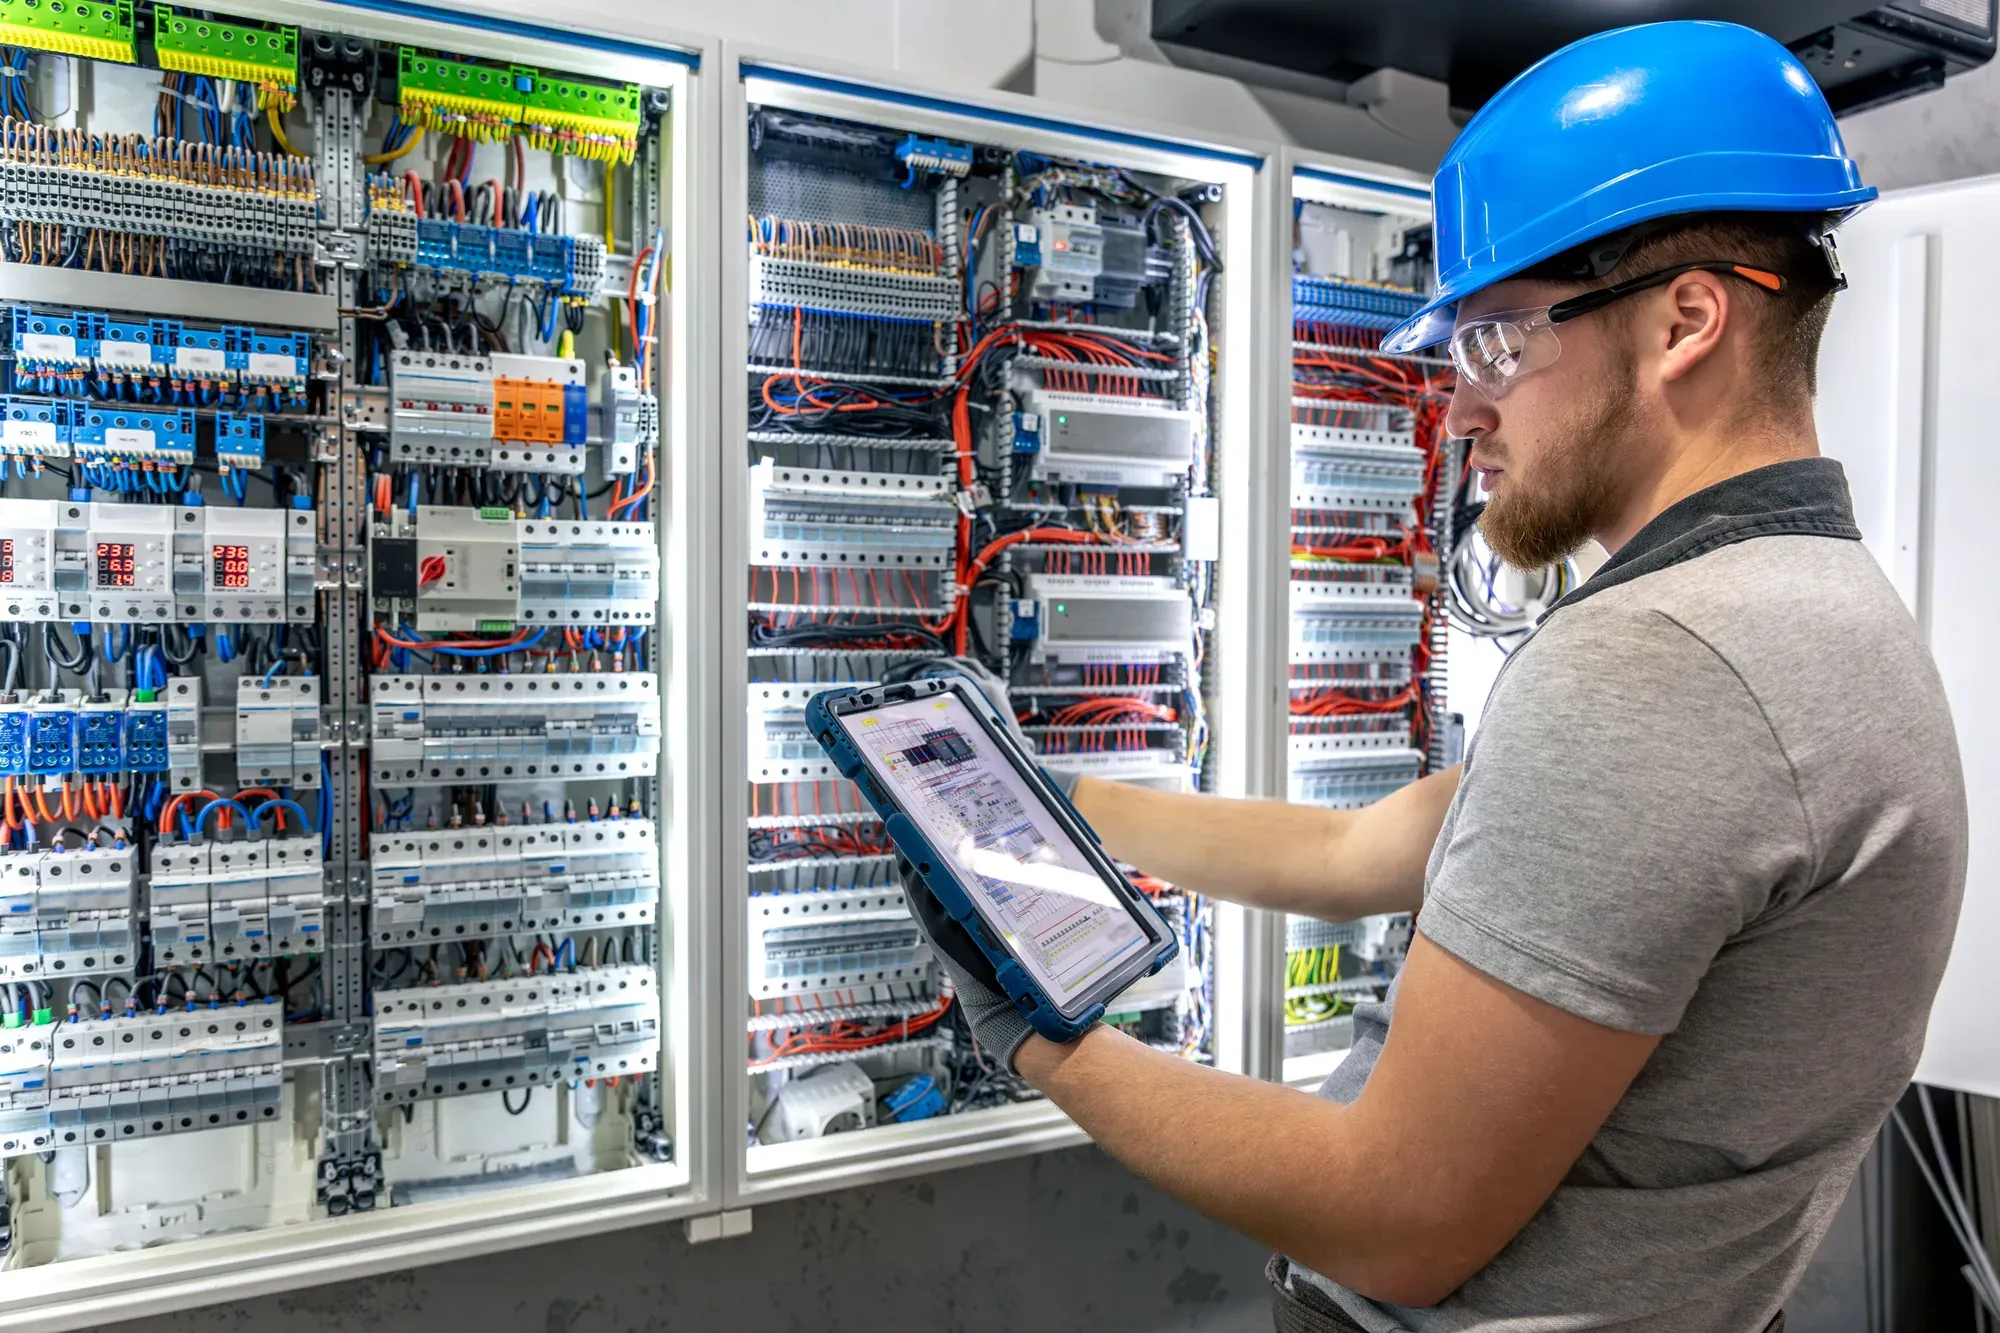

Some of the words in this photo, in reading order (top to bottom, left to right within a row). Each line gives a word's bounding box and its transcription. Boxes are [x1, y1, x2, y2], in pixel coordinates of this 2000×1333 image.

[96, 544, 135, 557] 231
[212, 545, 248, 559] 236
[109, 559, 134, 571] 6.3
[224, 560, 249, 573] 0.0
[378, 562, 388, 572] R
[403, 562, 413, 572] N
[116, 573, 135, 586] 1.4
[224, 574, 249, 587] 0.0
